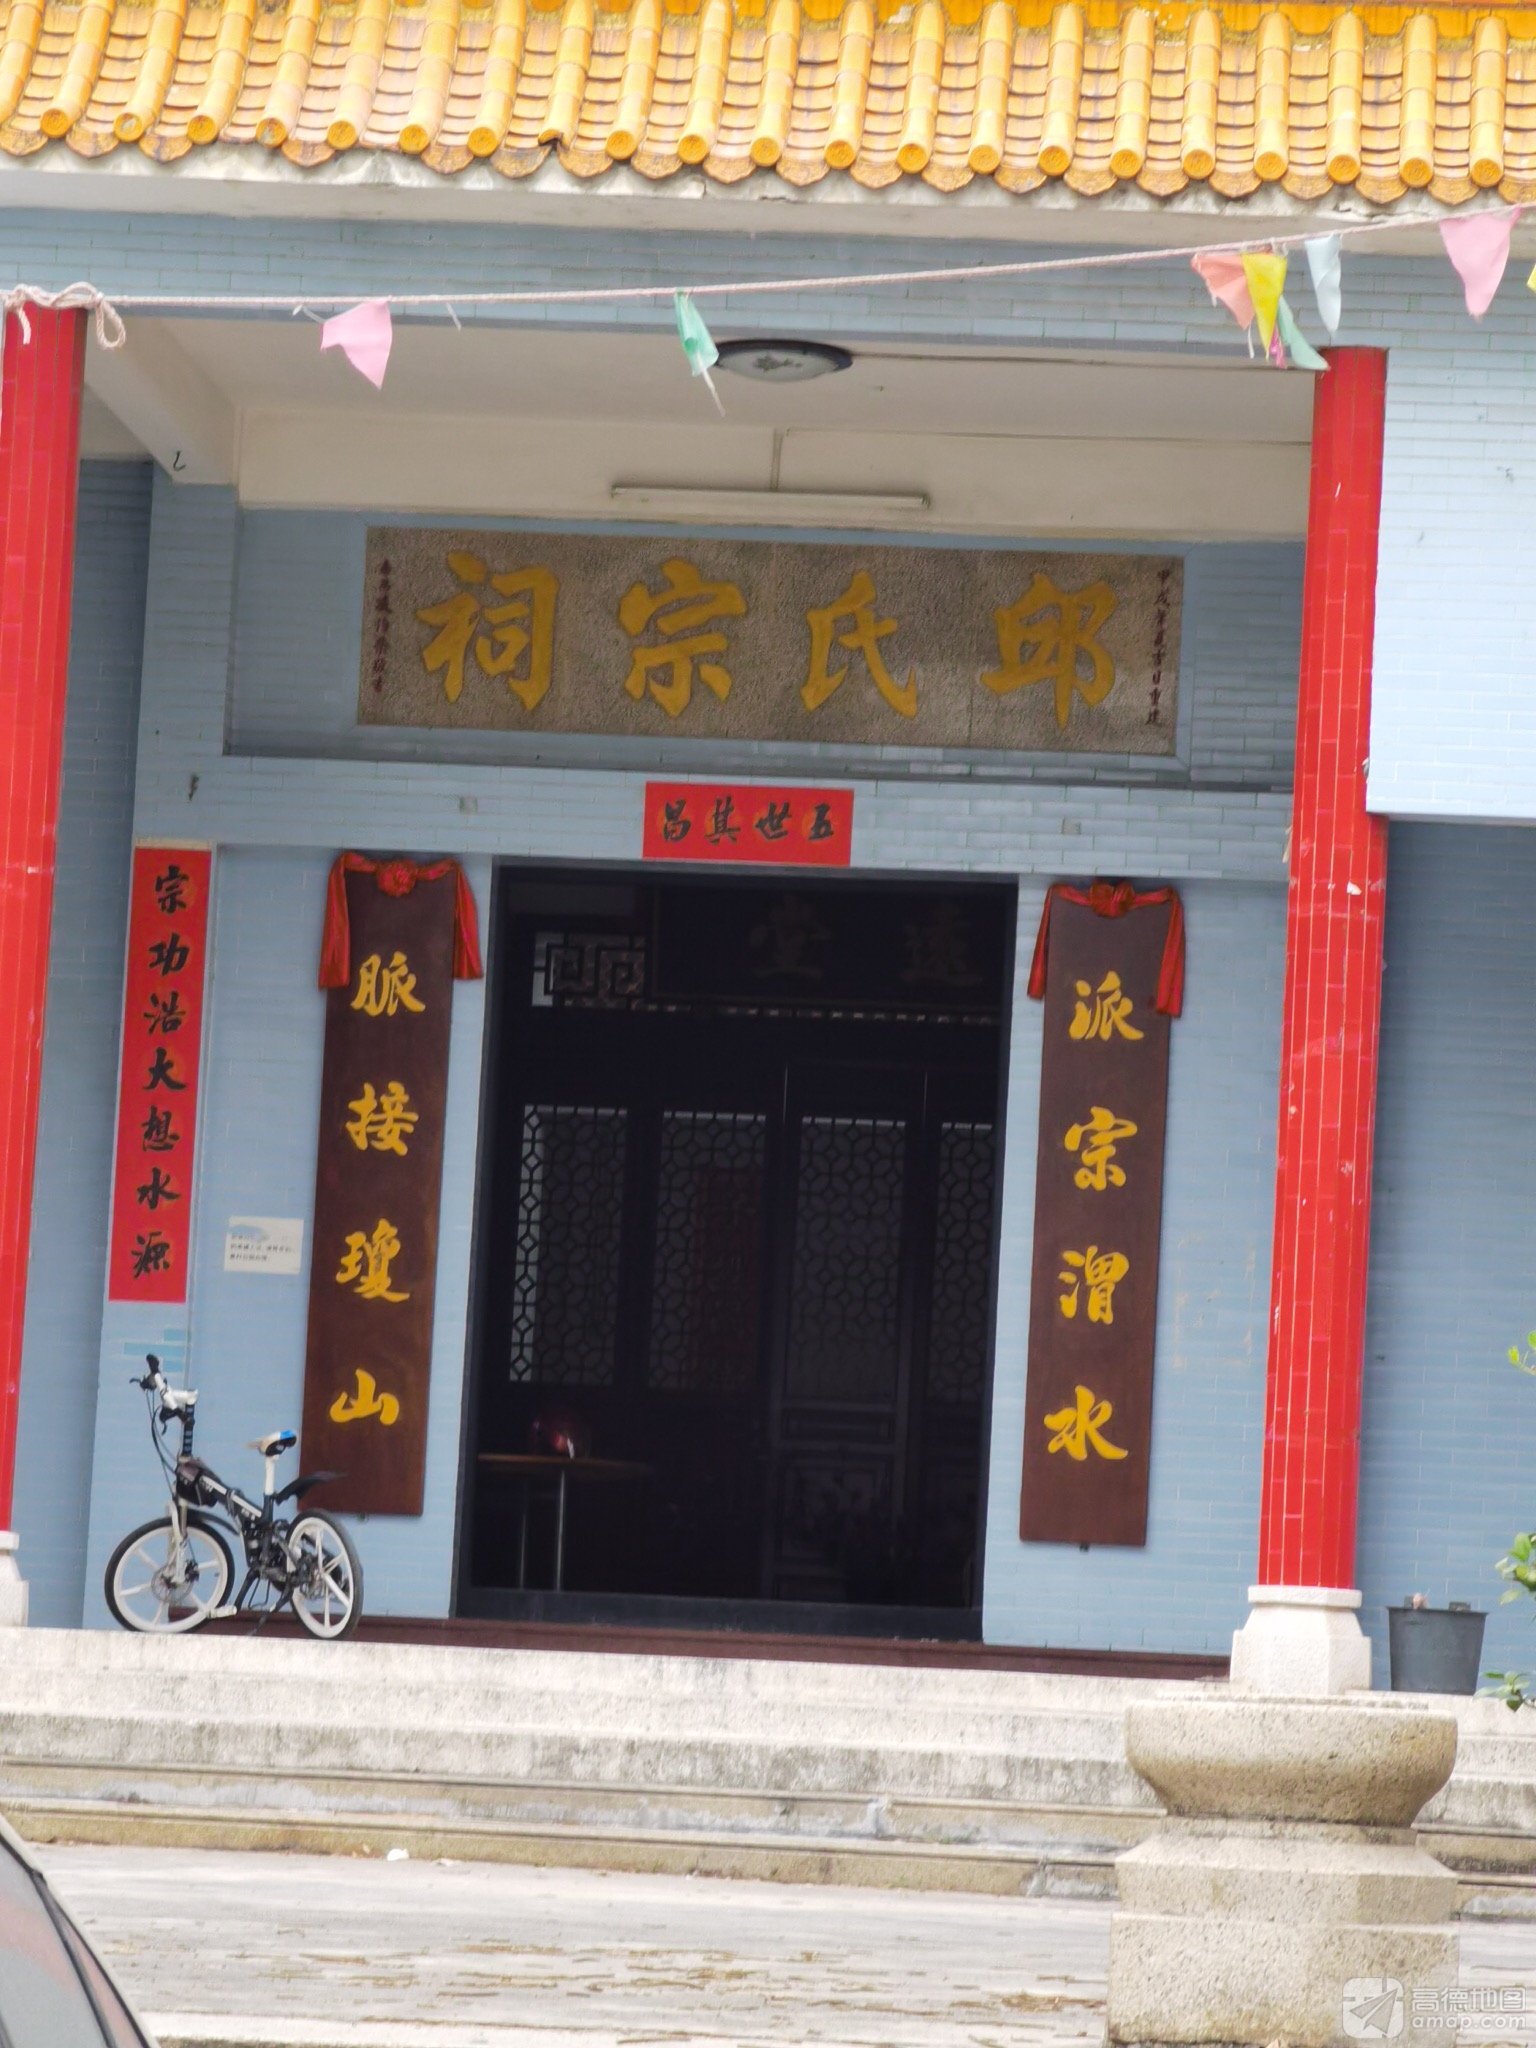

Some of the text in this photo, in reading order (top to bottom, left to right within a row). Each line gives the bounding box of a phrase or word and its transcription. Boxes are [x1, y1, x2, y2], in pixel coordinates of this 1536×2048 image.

[417, 551, 1118, 730] 邱氏宗祠
[662, 796, 835, 844] 五世其昌
[1043, 970, 1145, 1461] 派宗渭水
